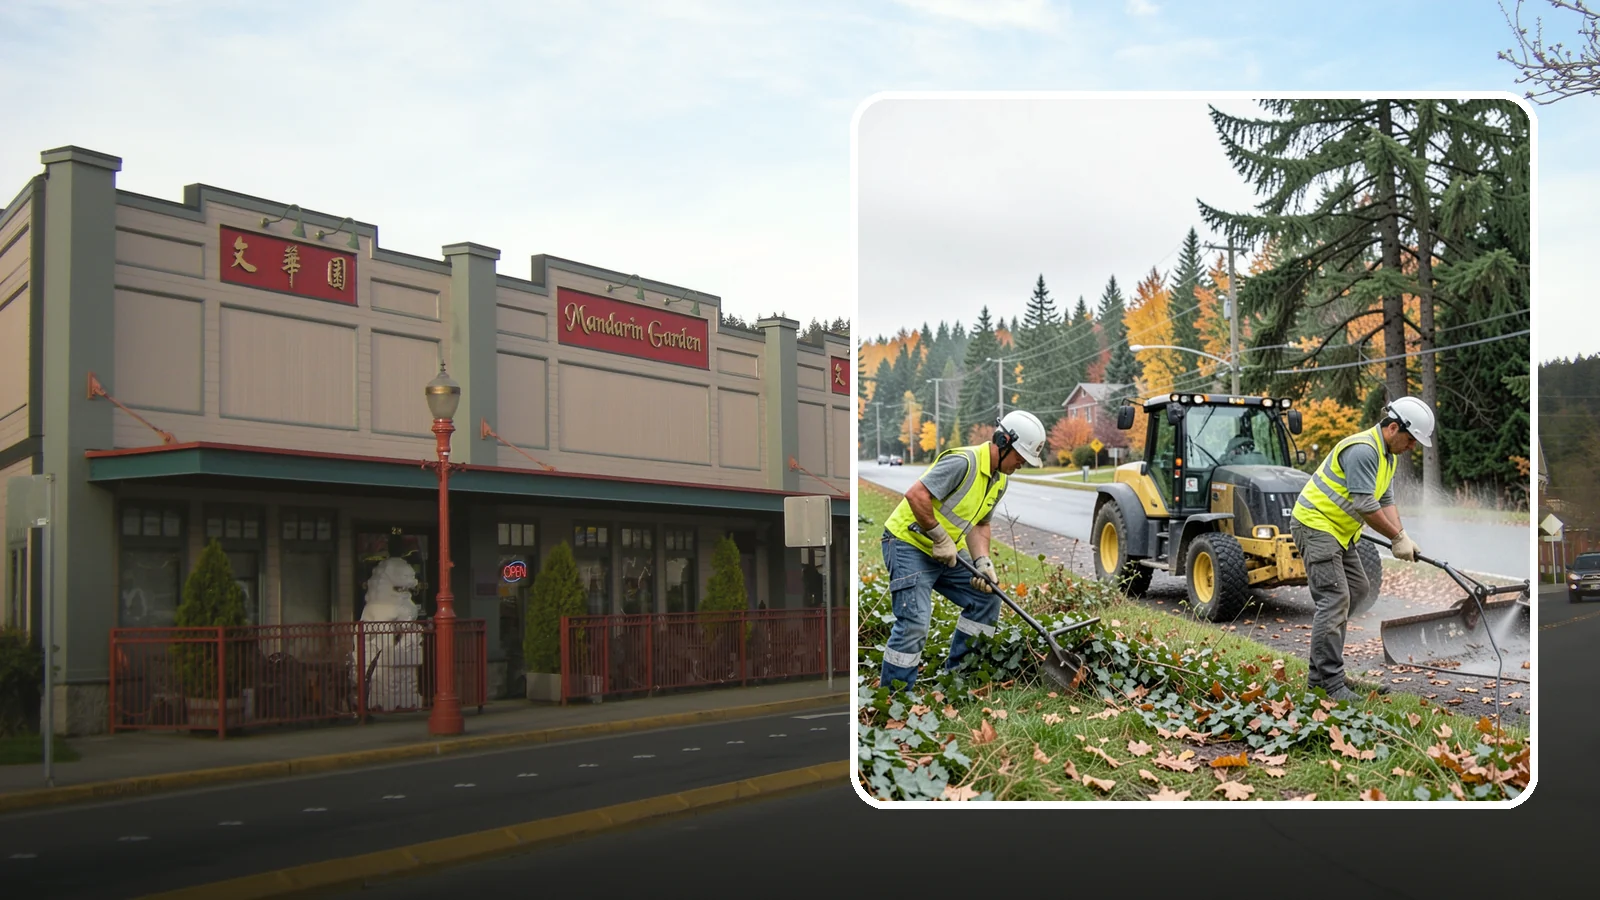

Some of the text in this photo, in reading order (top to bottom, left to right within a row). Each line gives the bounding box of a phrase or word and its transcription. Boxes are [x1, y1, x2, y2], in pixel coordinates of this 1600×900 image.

[231, 235, 346, 291] 文華園
[564, 302, 701, 352] Mandarin Garden
[503, 565, 527, 578] OPEN
